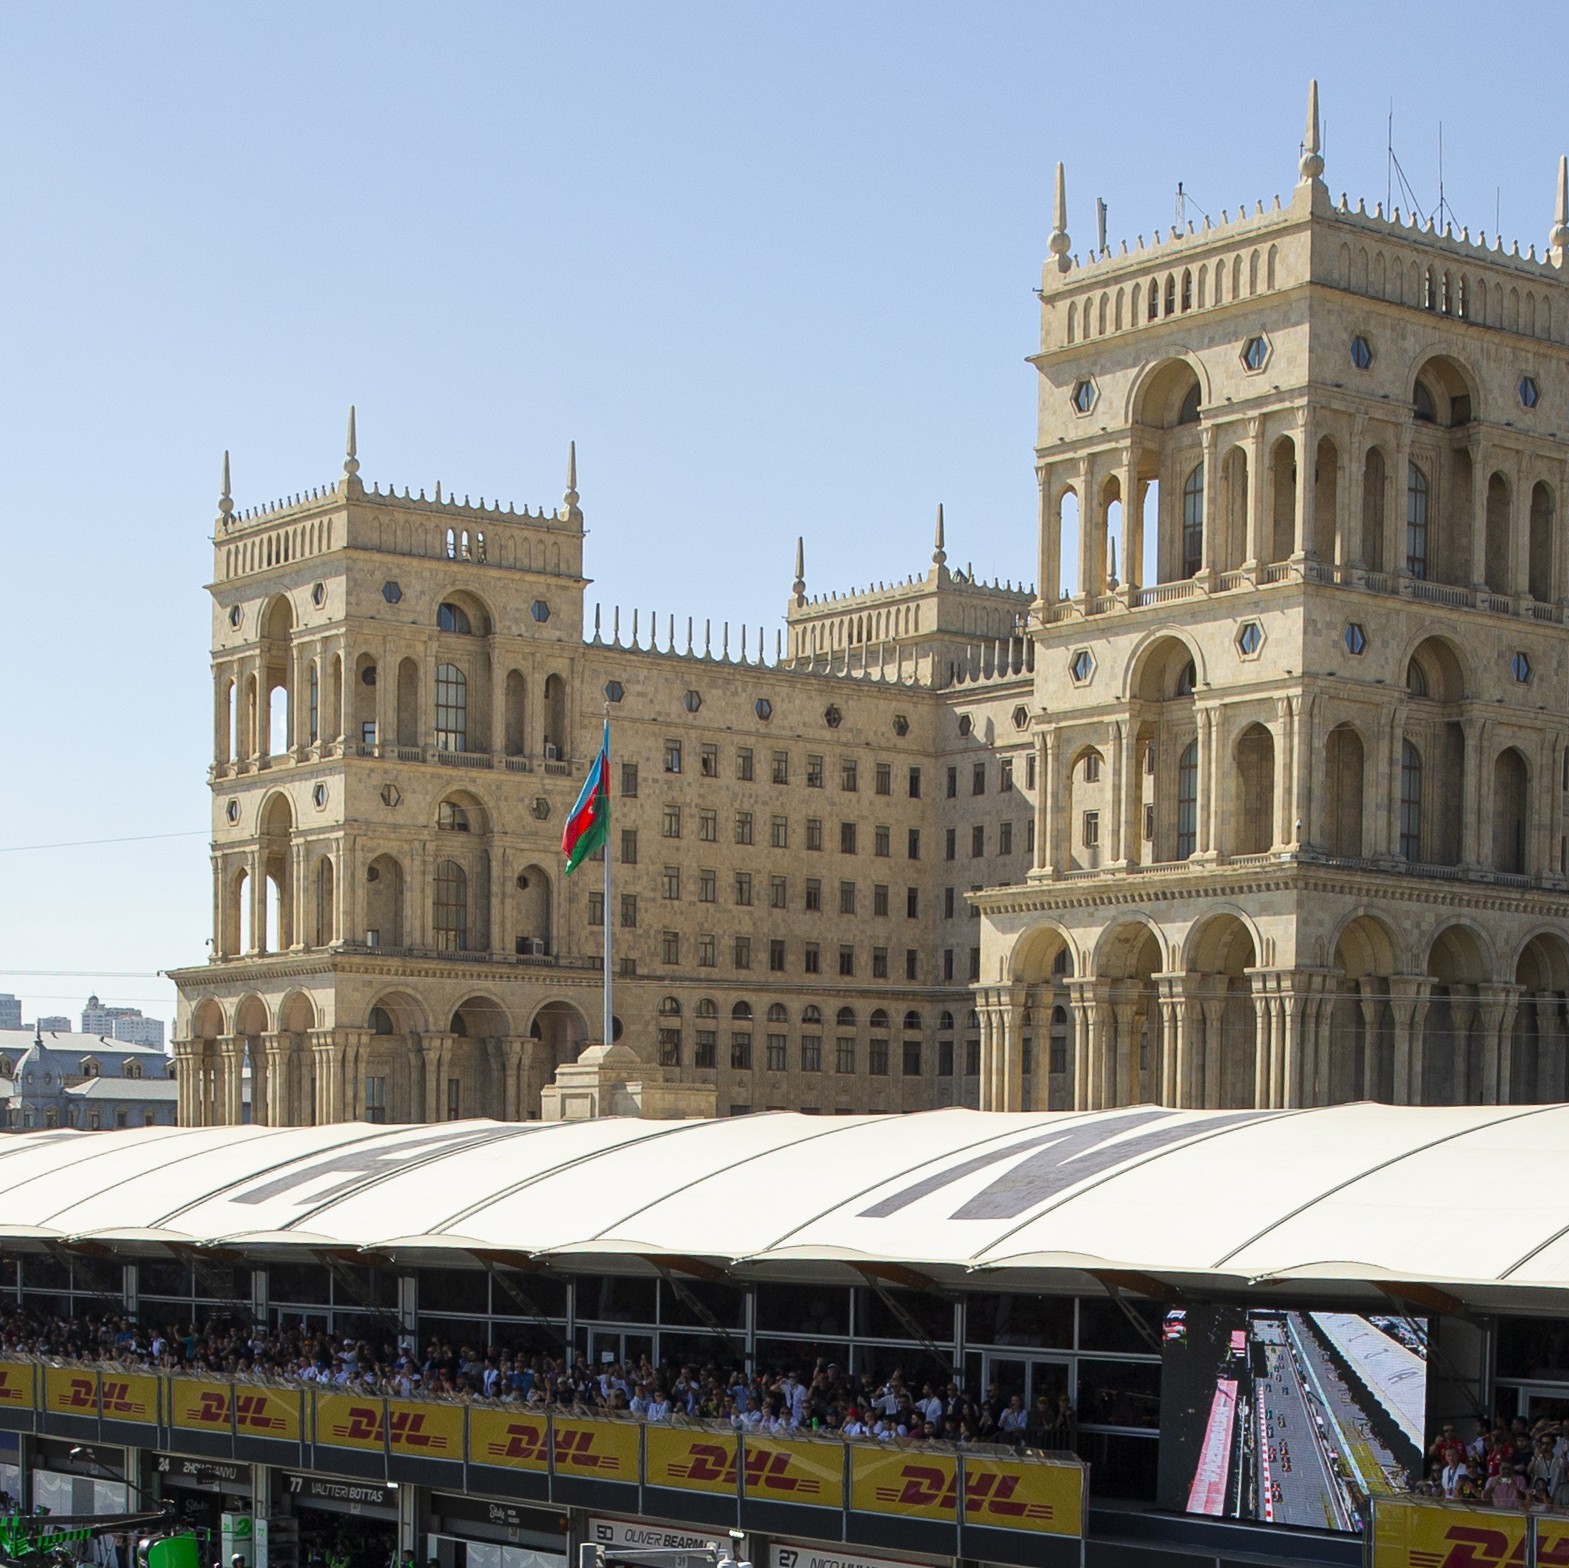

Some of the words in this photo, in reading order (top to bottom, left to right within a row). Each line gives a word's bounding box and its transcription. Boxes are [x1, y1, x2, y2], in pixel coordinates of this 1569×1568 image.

[71, 1378, 133, 1413] DHL
[200, 1391, 274, 1428] DHL
[347, 1407, 432, 1447] DHL
[505, 1423, 600, 1468] DHL
[158, 1458, 170, 1472] 24
[687, 1443, 800, 1492] DHL
[290, 1477, 303, 1493] 77
[311, 1482, 349, 1499] VALTTERI
[349, 1486, 384, 1503] BOTTAS
[899, 1465, 1029, 1517] DHL
[625, 1529, 663, 1547] OLIVER
[663, 1533, 722, 1550] BEARM
[779, 1549, 799, 1568] 27
